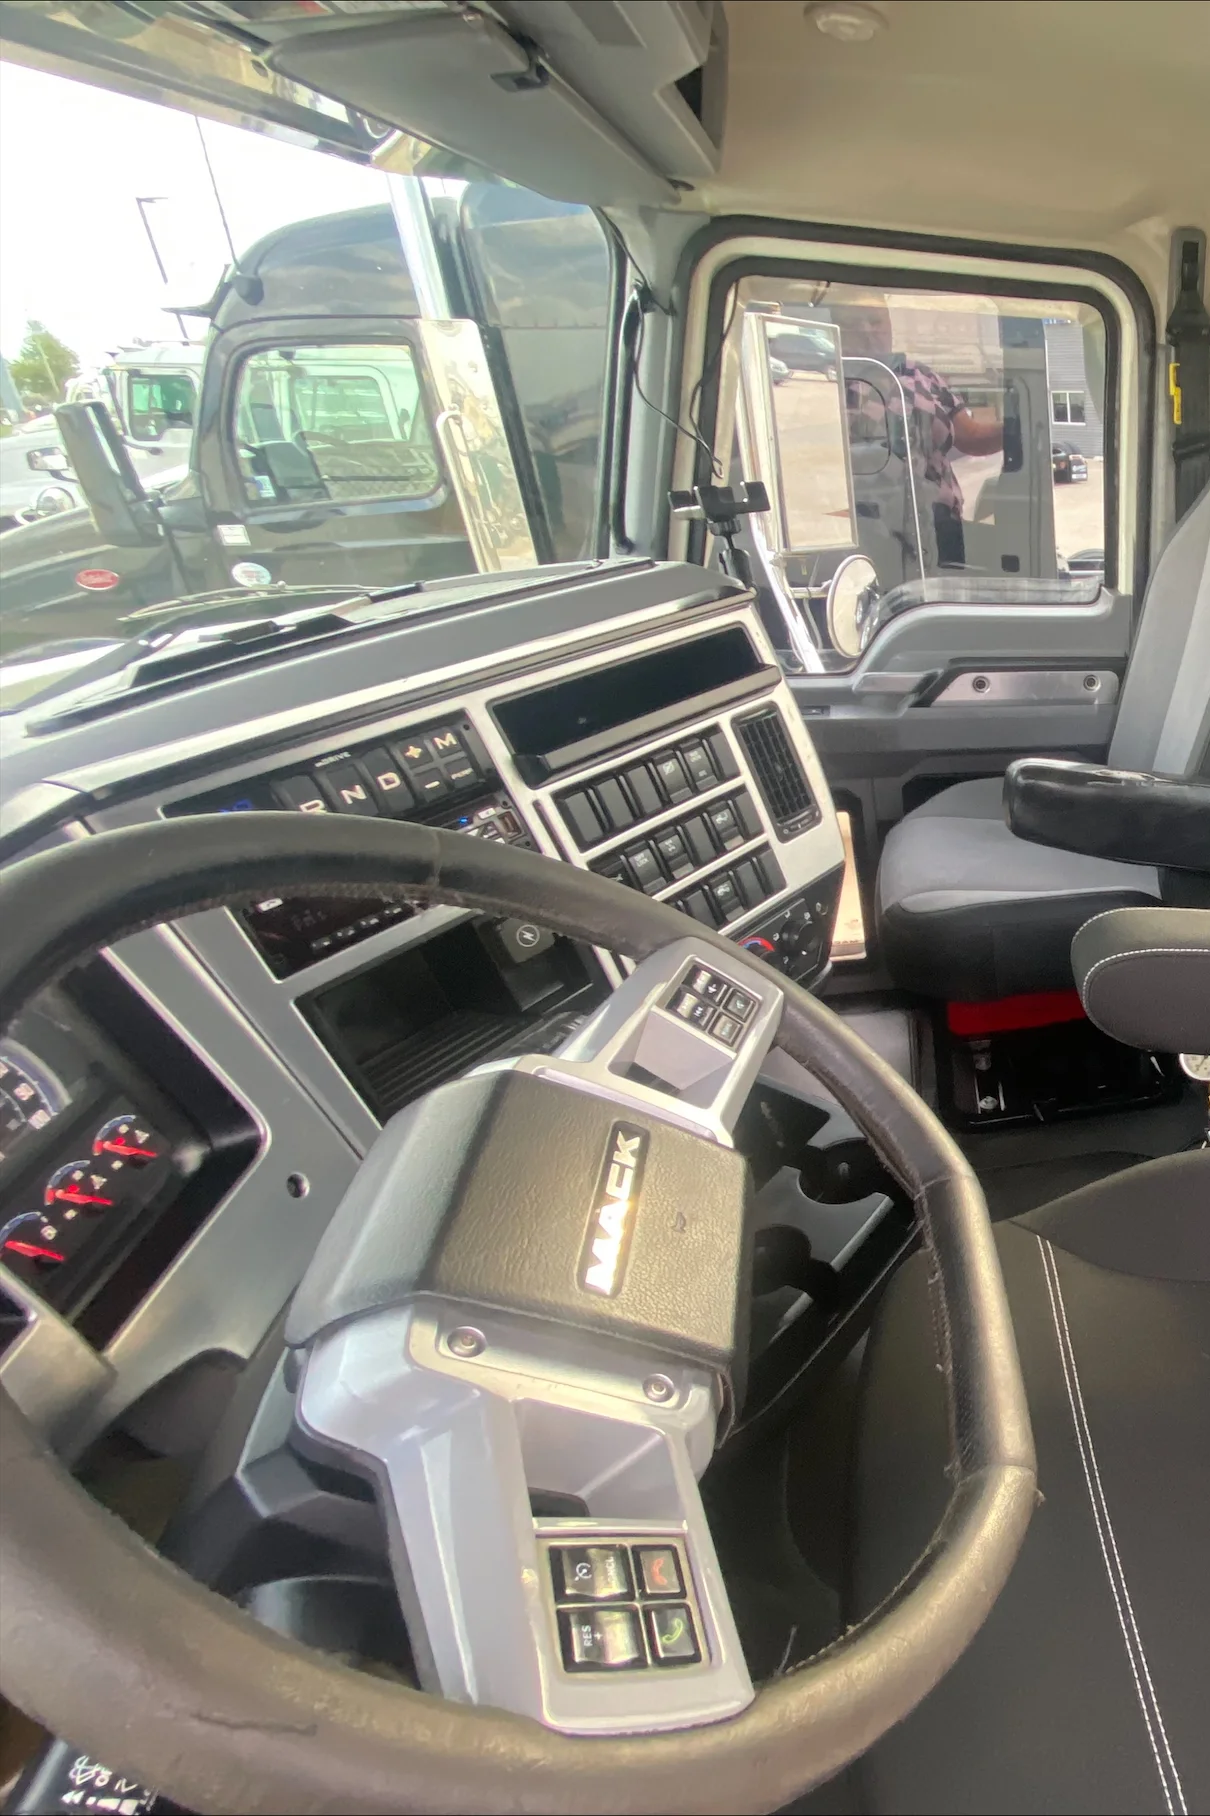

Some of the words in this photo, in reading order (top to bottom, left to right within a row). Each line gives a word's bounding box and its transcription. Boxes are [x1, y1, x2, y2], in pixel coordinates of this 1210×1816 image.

[433, 732, 457, 750] M
[378, 771, 401, 790] D
[341, 784, 367, 804] N
[584, 1130, 641, 1296] MACK
[581, 1624, 594, 1648] RES
